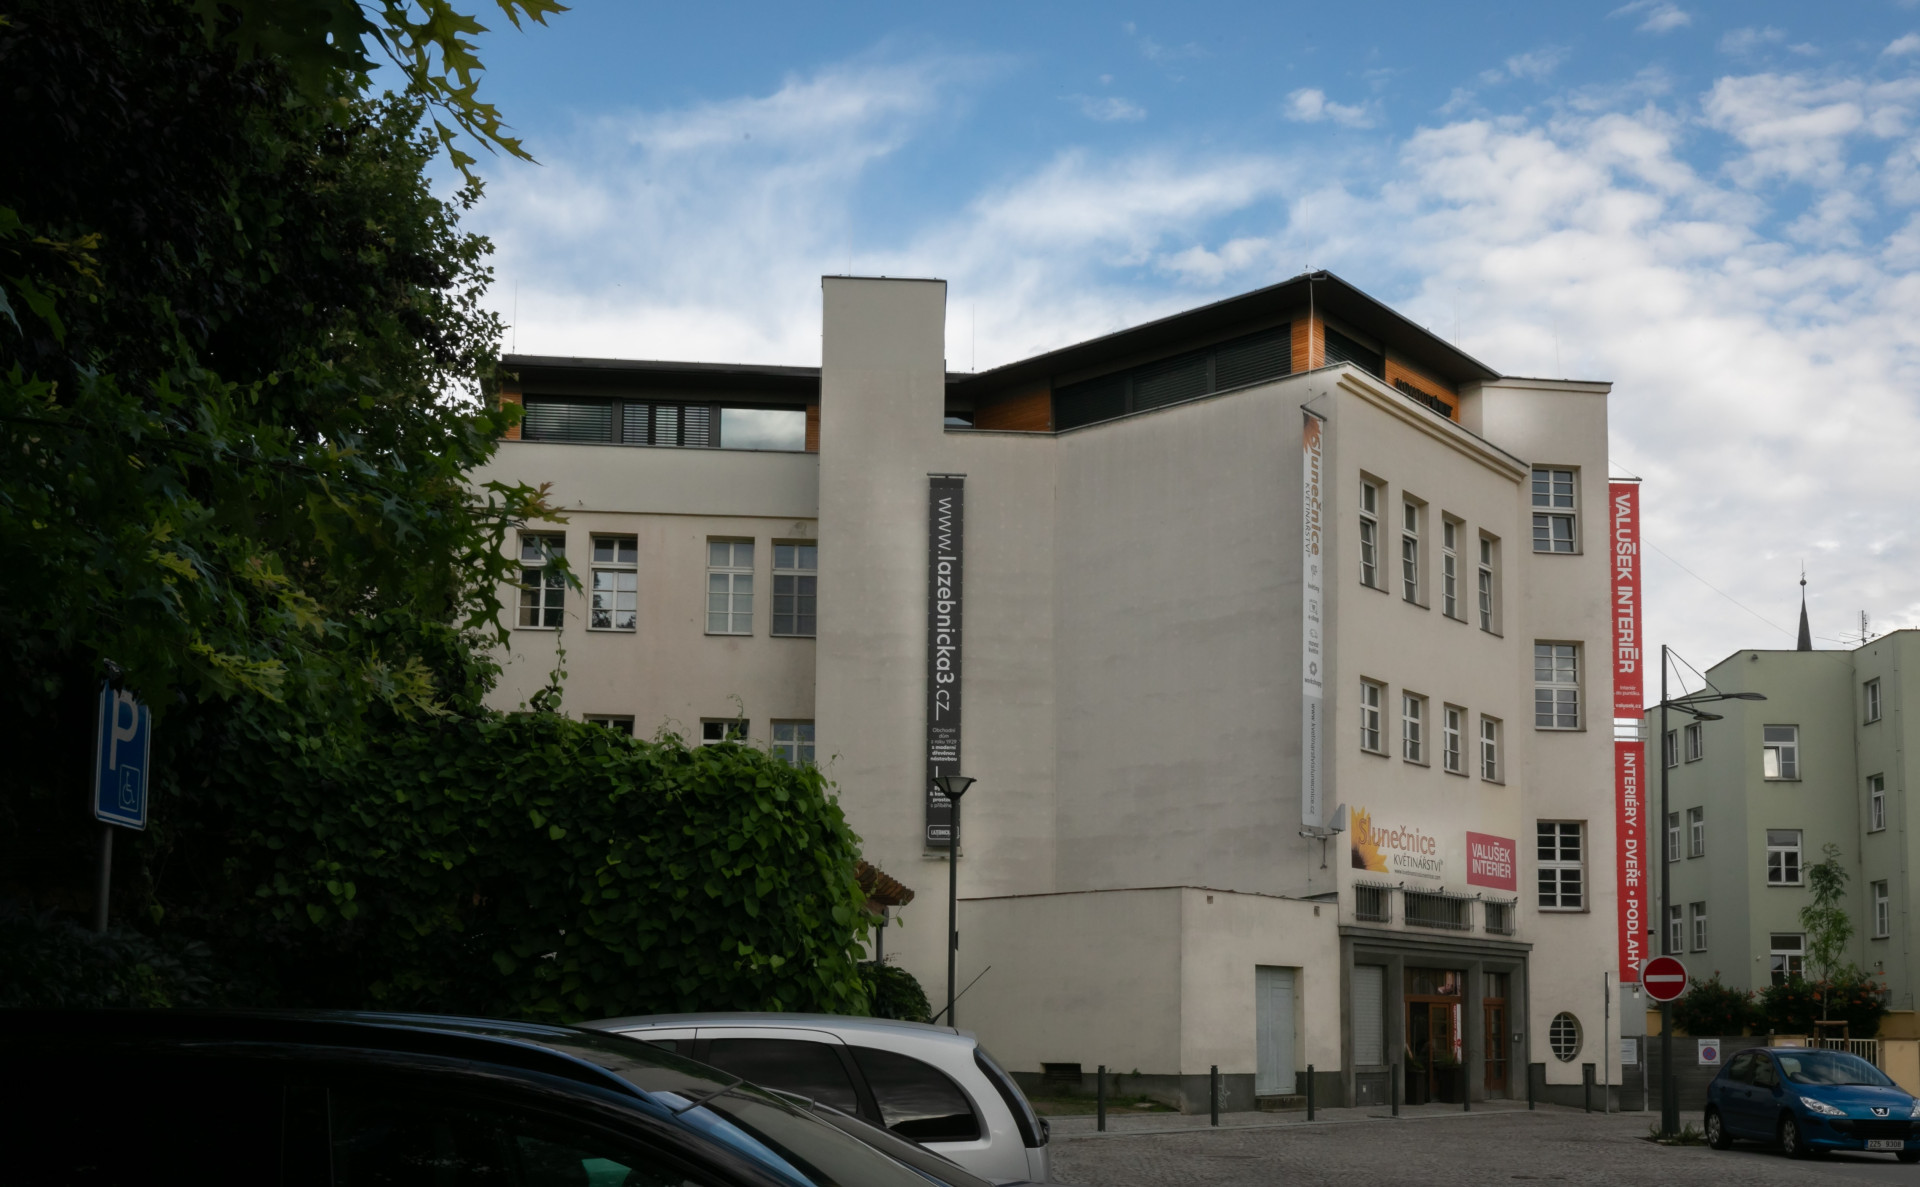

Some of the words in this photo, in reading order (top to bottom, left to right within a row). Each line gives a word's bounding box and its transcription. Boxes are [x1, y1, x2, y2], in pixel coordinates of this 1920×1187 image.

[1616, 493, 1636, 580] VALUŠEK
[936, 497, 957, 720] www.lazebnicka3.cz
[109, 688, 139, 771] P
[1624, 752, 1640, 827] INTERIÉRY
[1359, 816, 1436, 856] Slunečnice
[1472, 841, 1511, 864] VALUŠEK
[1625, 839, 1641, 887] DVEŘE
[1626, 899, 1639, 971] PODLAHY
